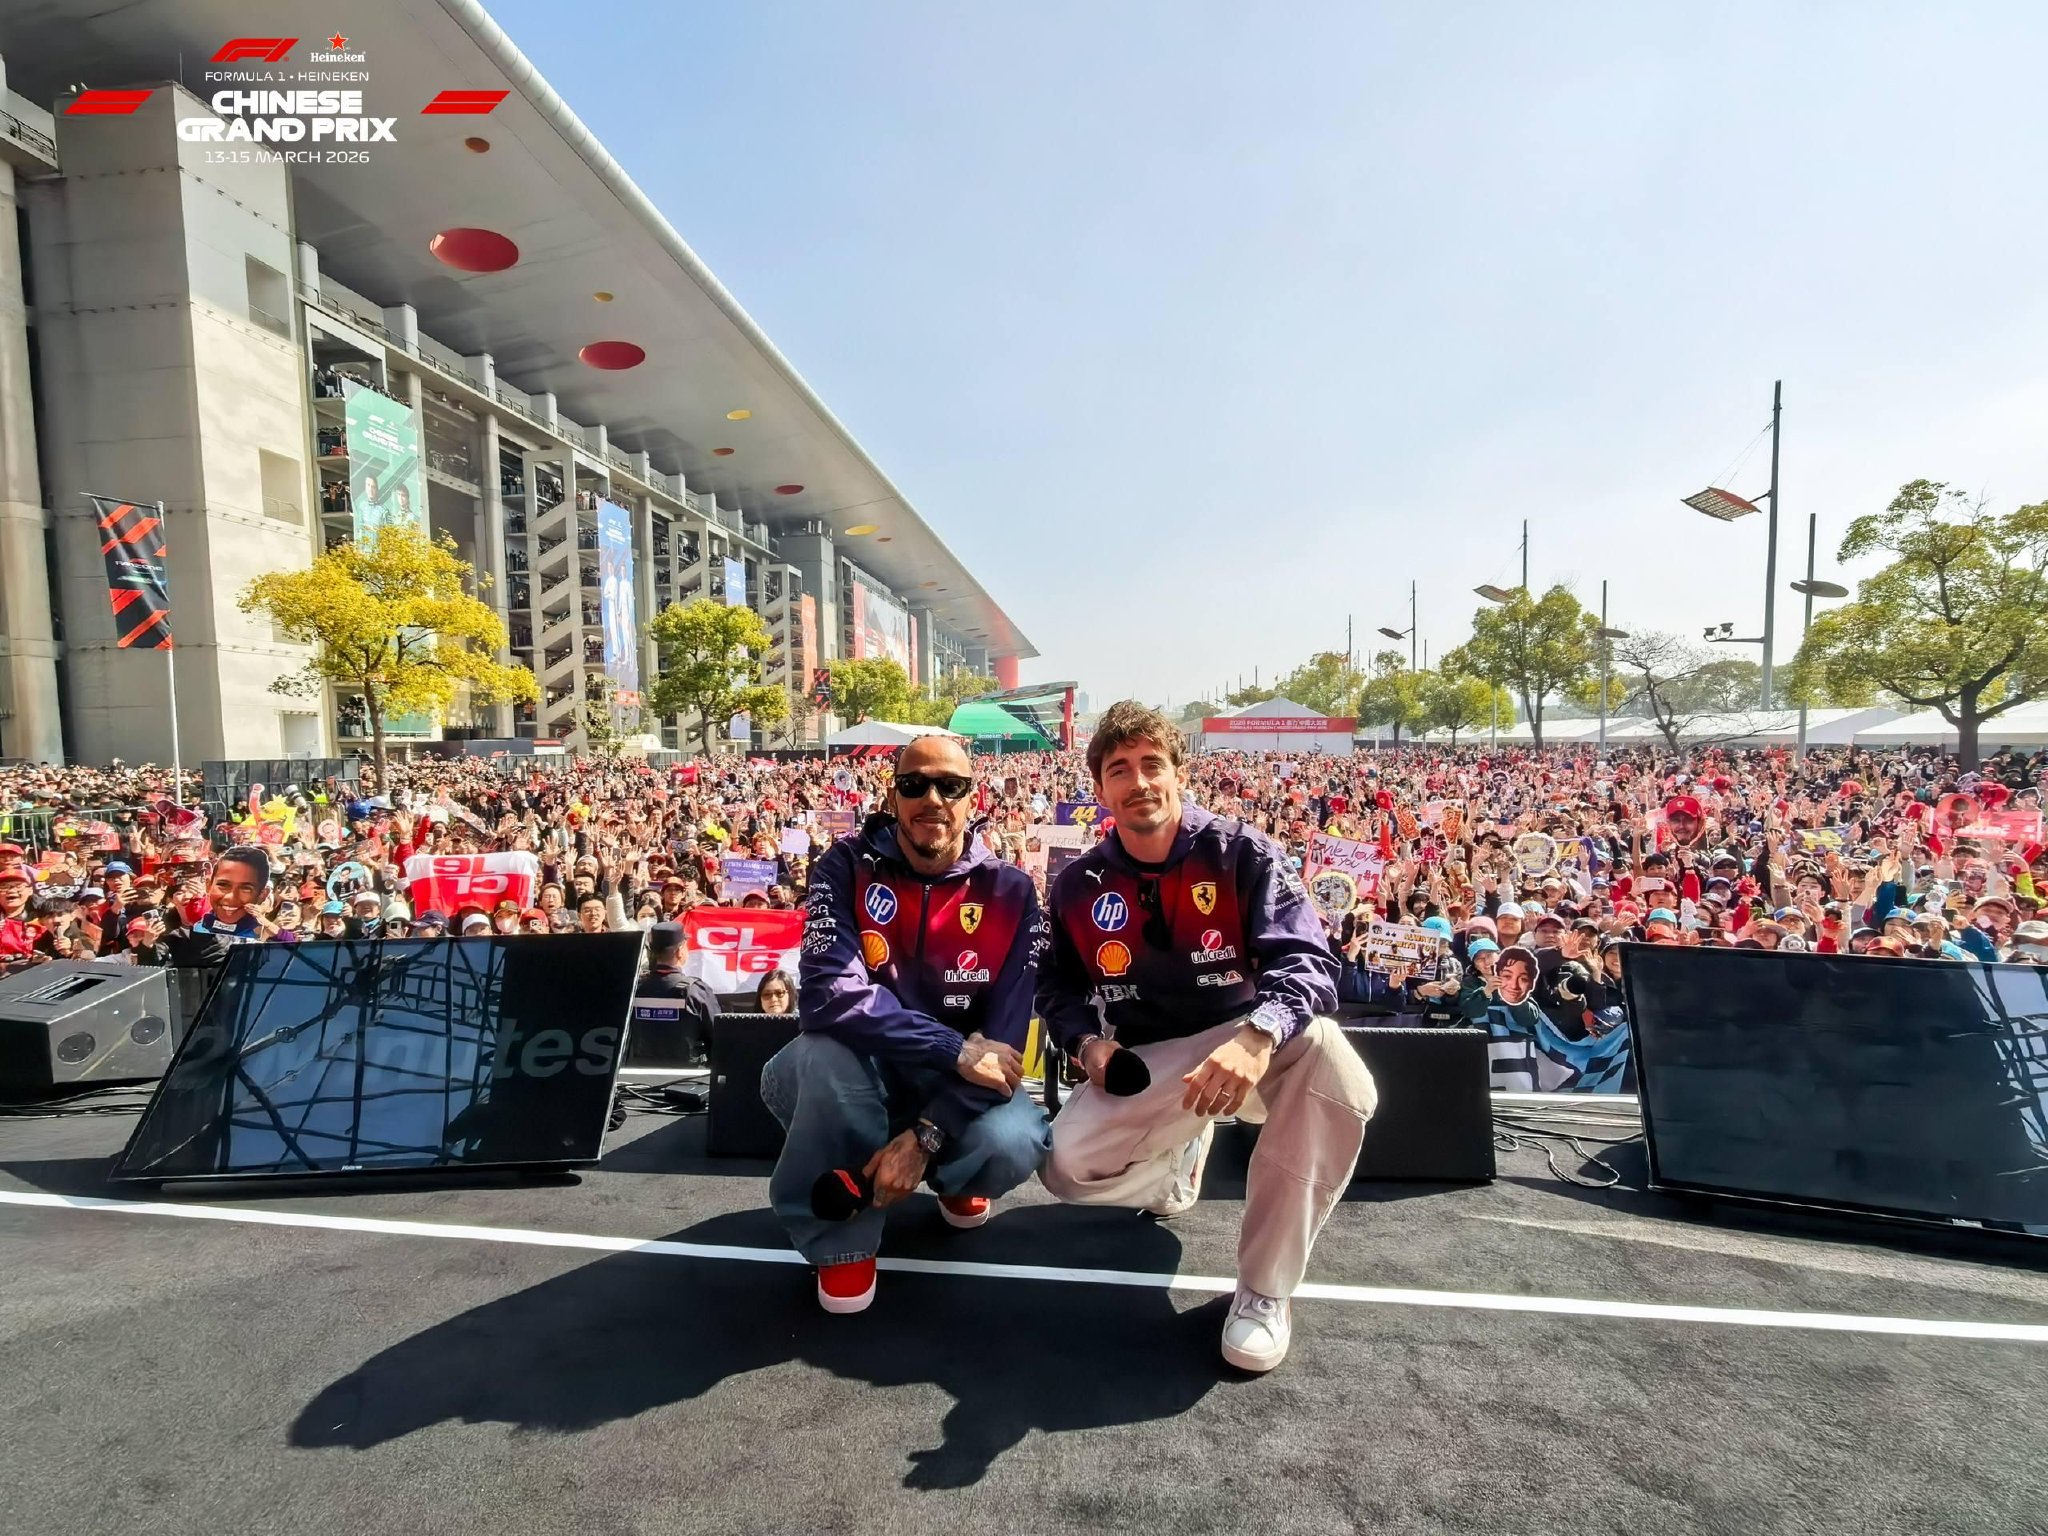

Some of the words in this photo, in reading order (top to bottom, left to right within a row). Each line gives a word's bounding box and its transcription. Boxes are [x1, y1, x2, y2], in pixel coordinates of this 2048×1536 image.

[1069, 805, 1098, 822] 44
[867, 882, 894, 922] hp
[1097, 893, 1124, 931] hp
[697, 926, 769, 950] CL
[713, 952, 781, 973] 16
[1190, 945, 1237, 964] UniCredit
[944, 968, 989, 983] UniCredit
[1101, 984, 1142, 1003] IBM
